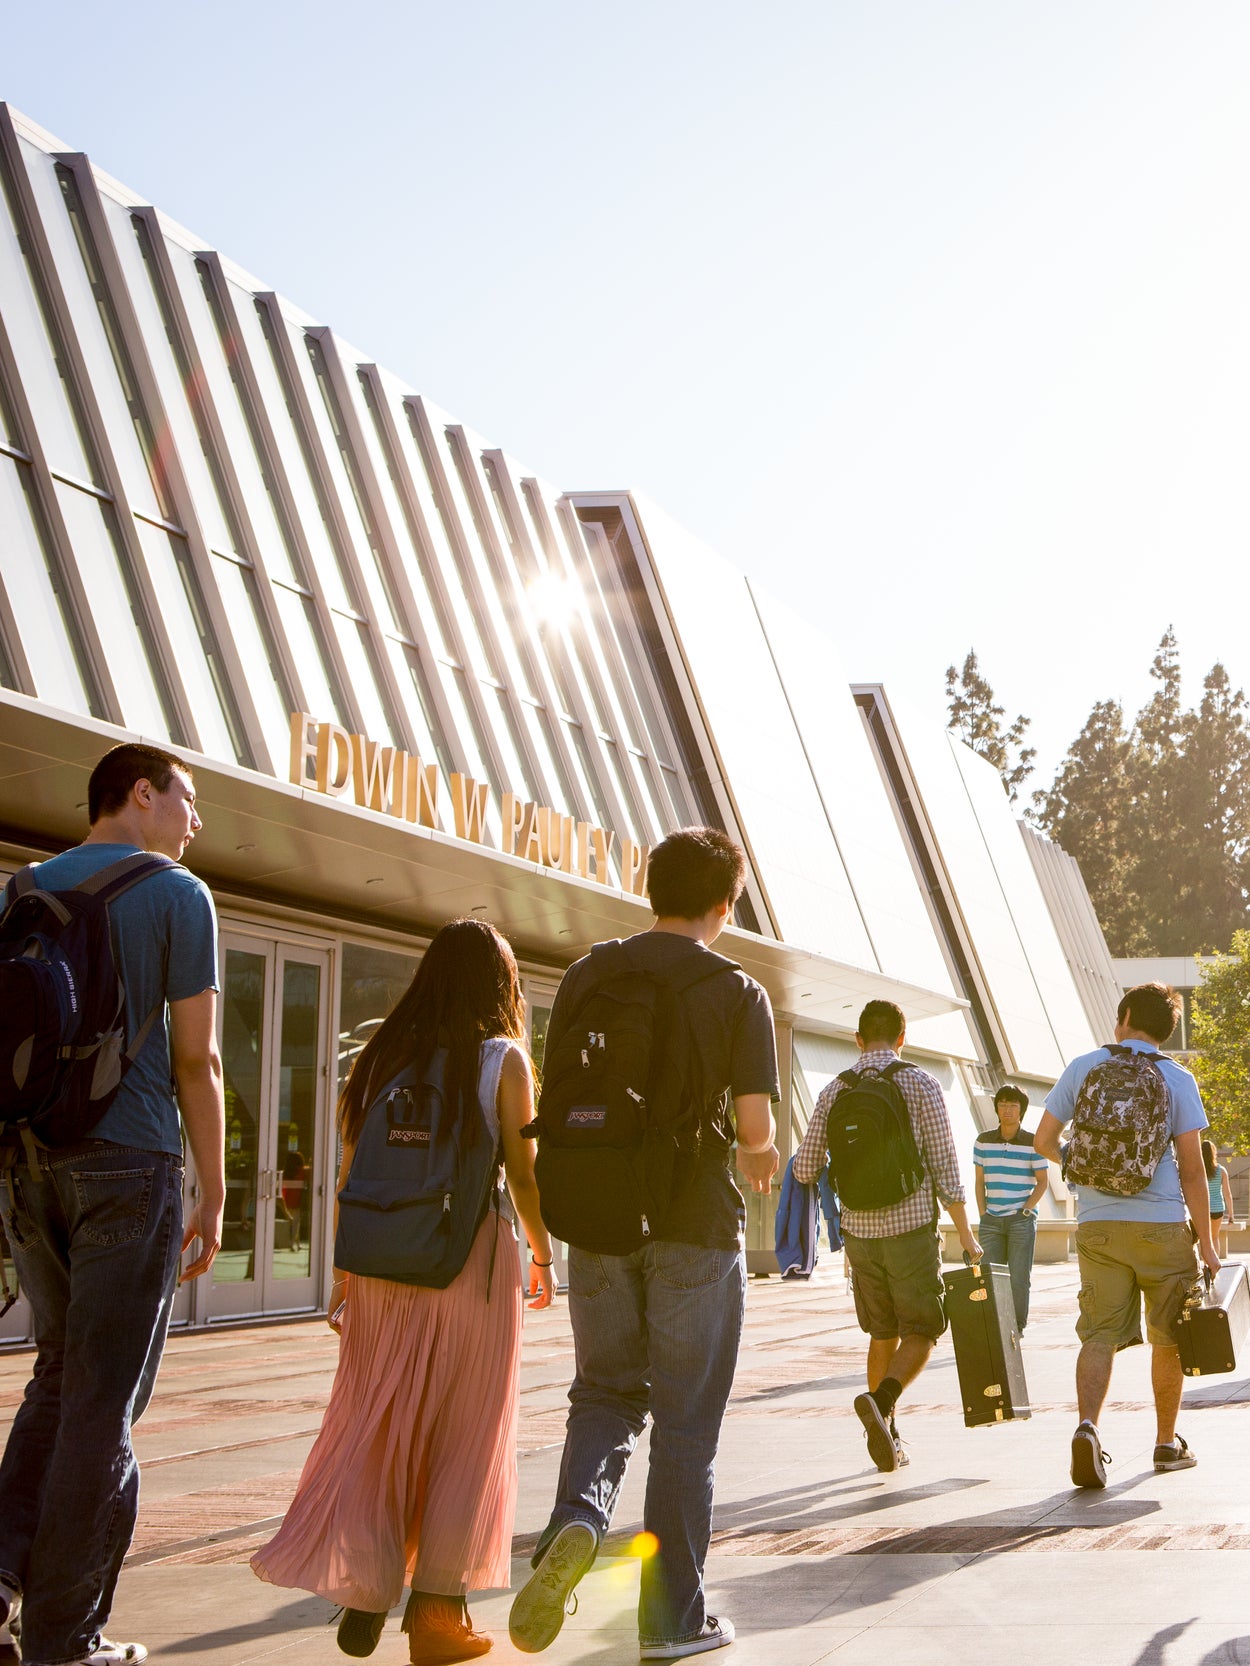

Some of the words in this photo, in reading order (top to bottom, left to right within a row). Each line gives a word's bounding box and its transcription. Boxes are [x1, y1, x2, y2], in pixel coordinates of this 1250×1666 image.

[289, 711, 439, 829] EDWIN
[502, 792, 615, 885] PAULEY
[70, 991, 78, 1013] HIGH
